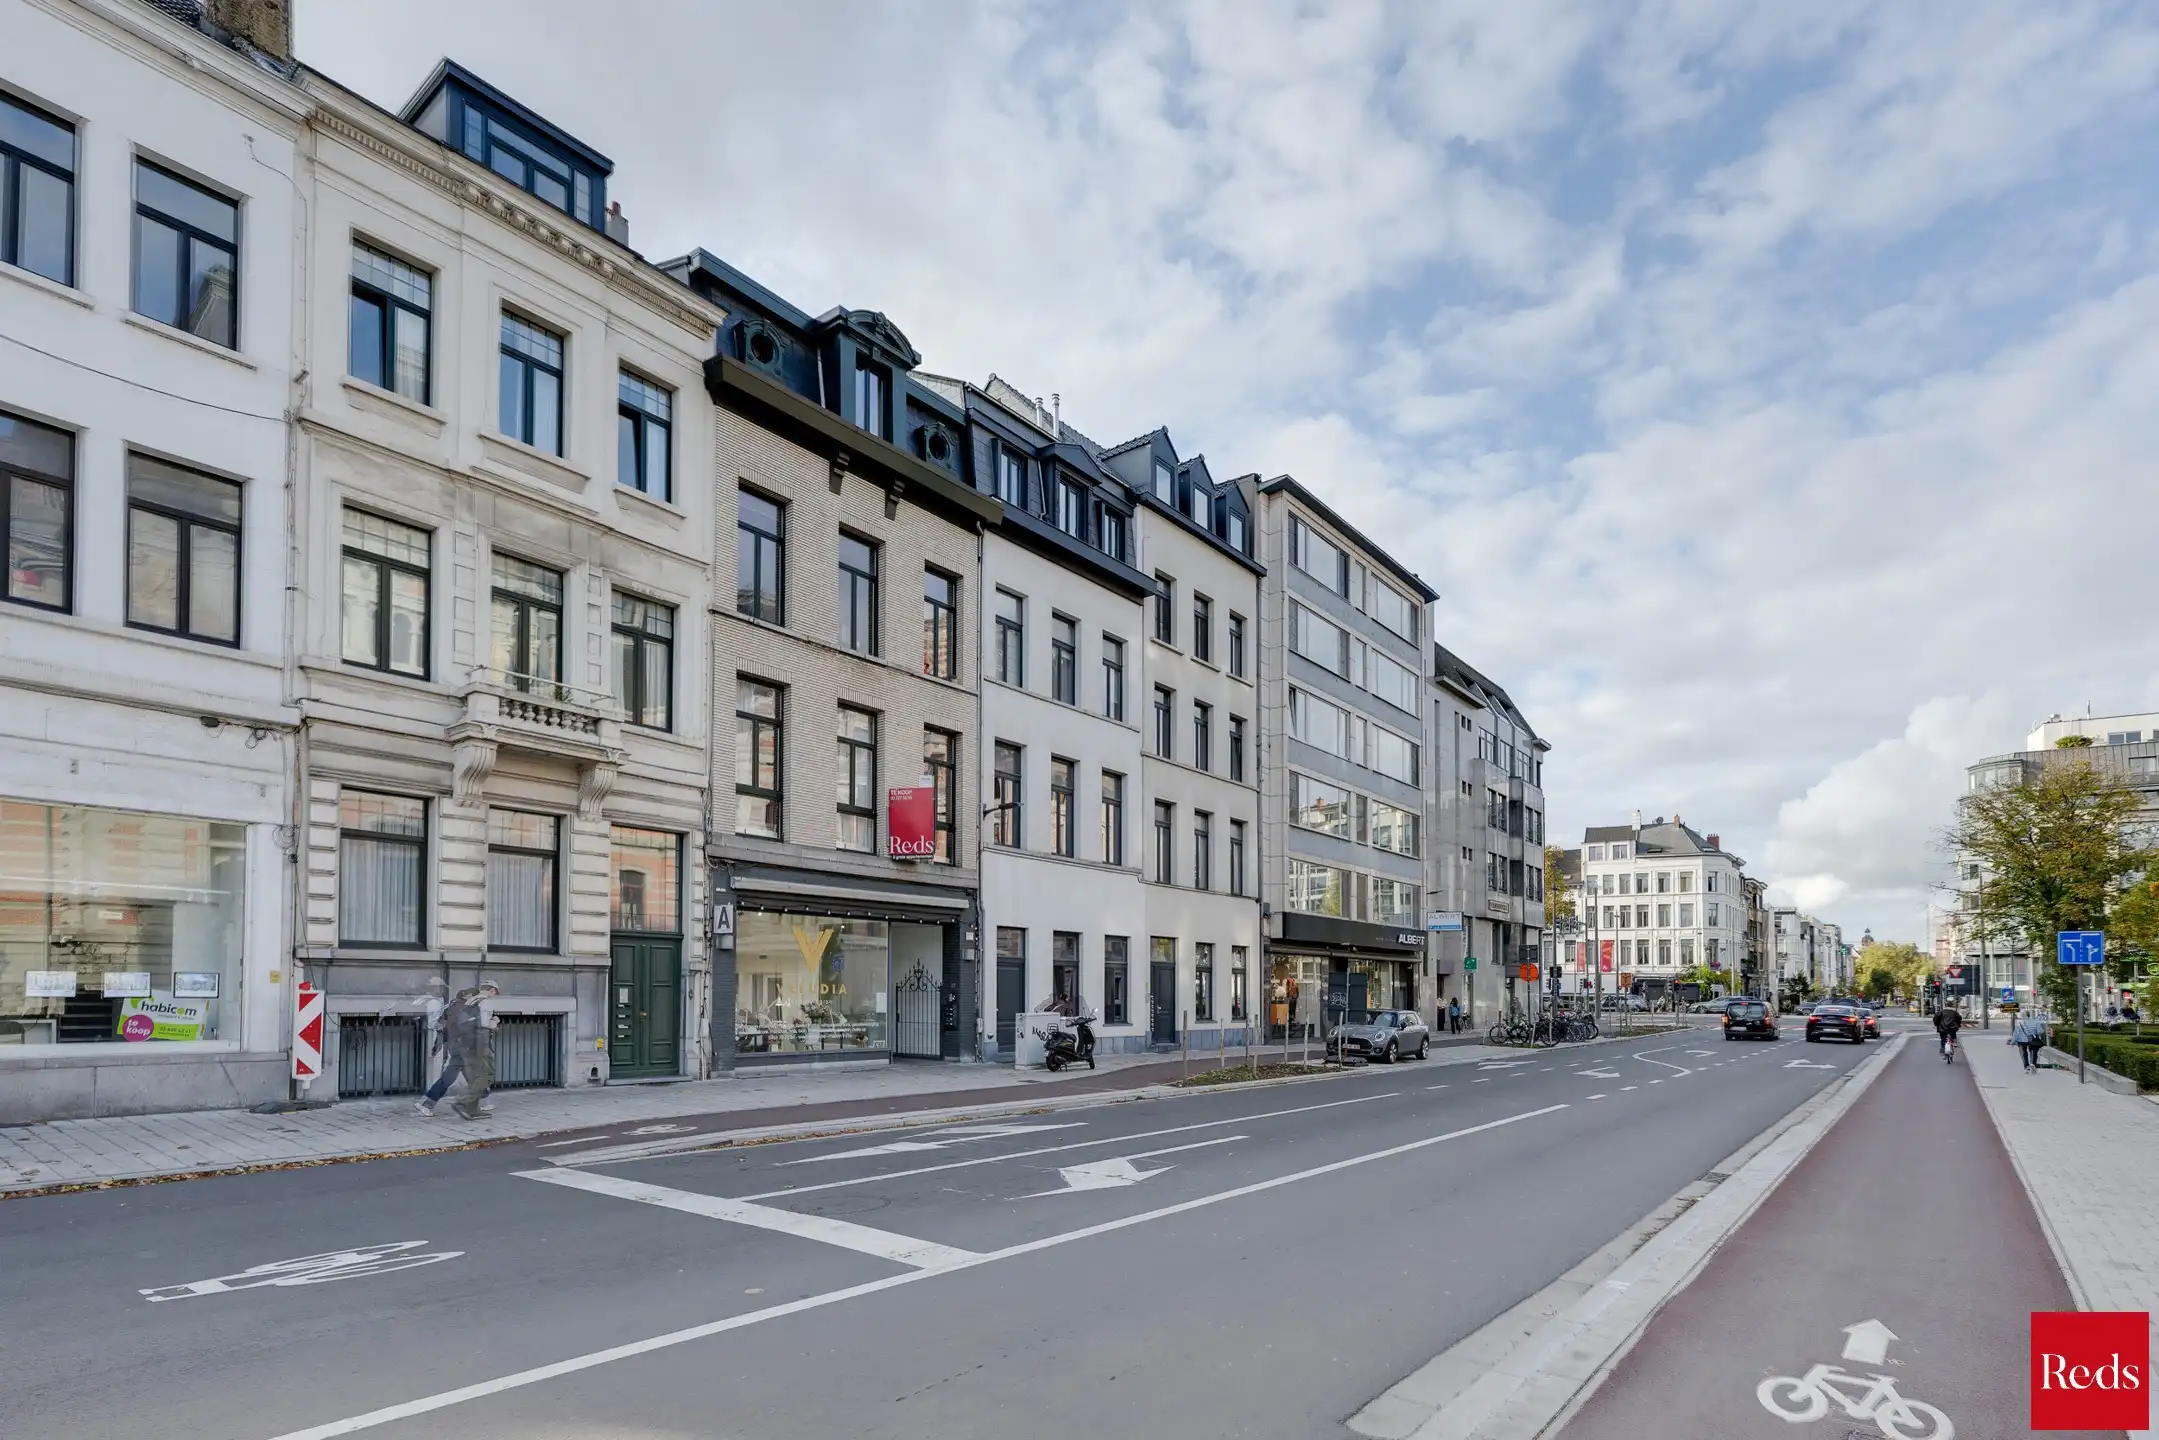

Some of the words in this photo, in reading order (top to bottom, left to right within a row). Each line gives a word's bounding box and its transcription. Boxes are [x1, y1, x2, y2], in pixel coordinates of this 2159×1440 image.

[889, 835, 934, 854] Reds
[717, 906, 730, 929] A
[1398, 933, 1425, 946] ALBERT
[127, 1019, 139, 1027] te
[126, 1025, 151, 1036] koop
